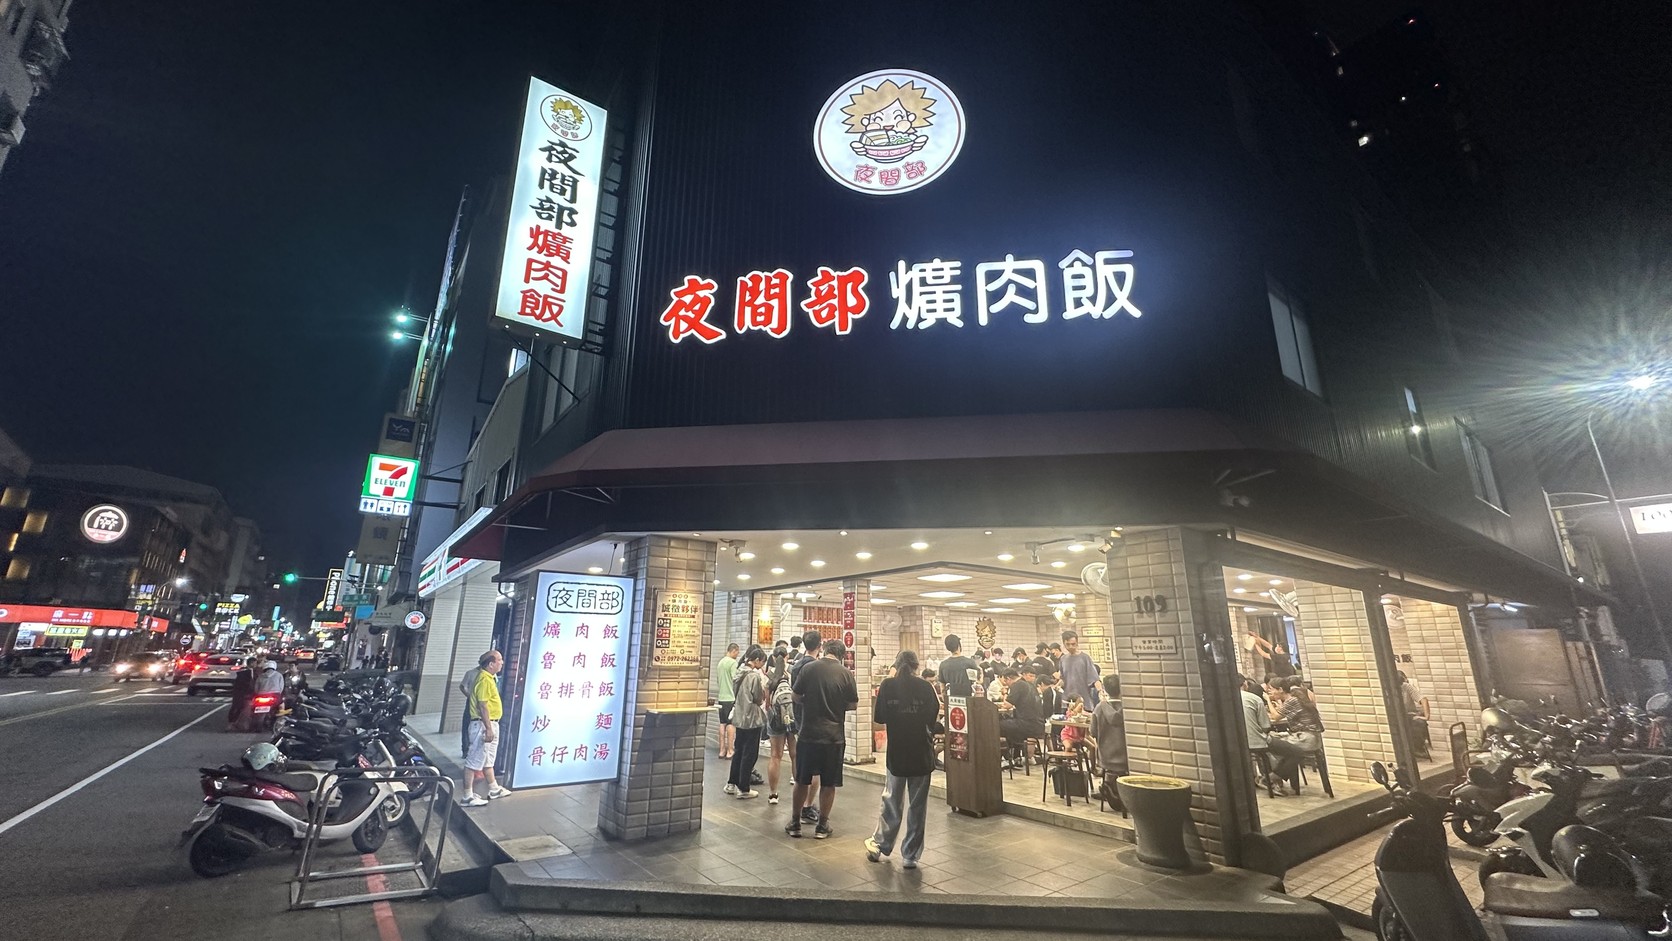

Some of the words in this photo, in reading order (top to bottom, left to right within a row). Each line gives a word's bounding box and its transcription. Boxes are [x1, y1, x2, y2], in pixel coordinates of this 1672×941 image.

[853, 160, 928, 187] 夜間部
[659, 265, 871, 345] 夜間部
[552, 587, 620, 610] 夜間部
[1134, 594, 1167, 614] 109
[543, 621, 620, 639] 爌肉飯
[540, 651, 617, 670] 魯肉飯
[538, 680, 615, 700] 魯排骨飯
[528, 743, 610, 766] 骨仔肉湯
